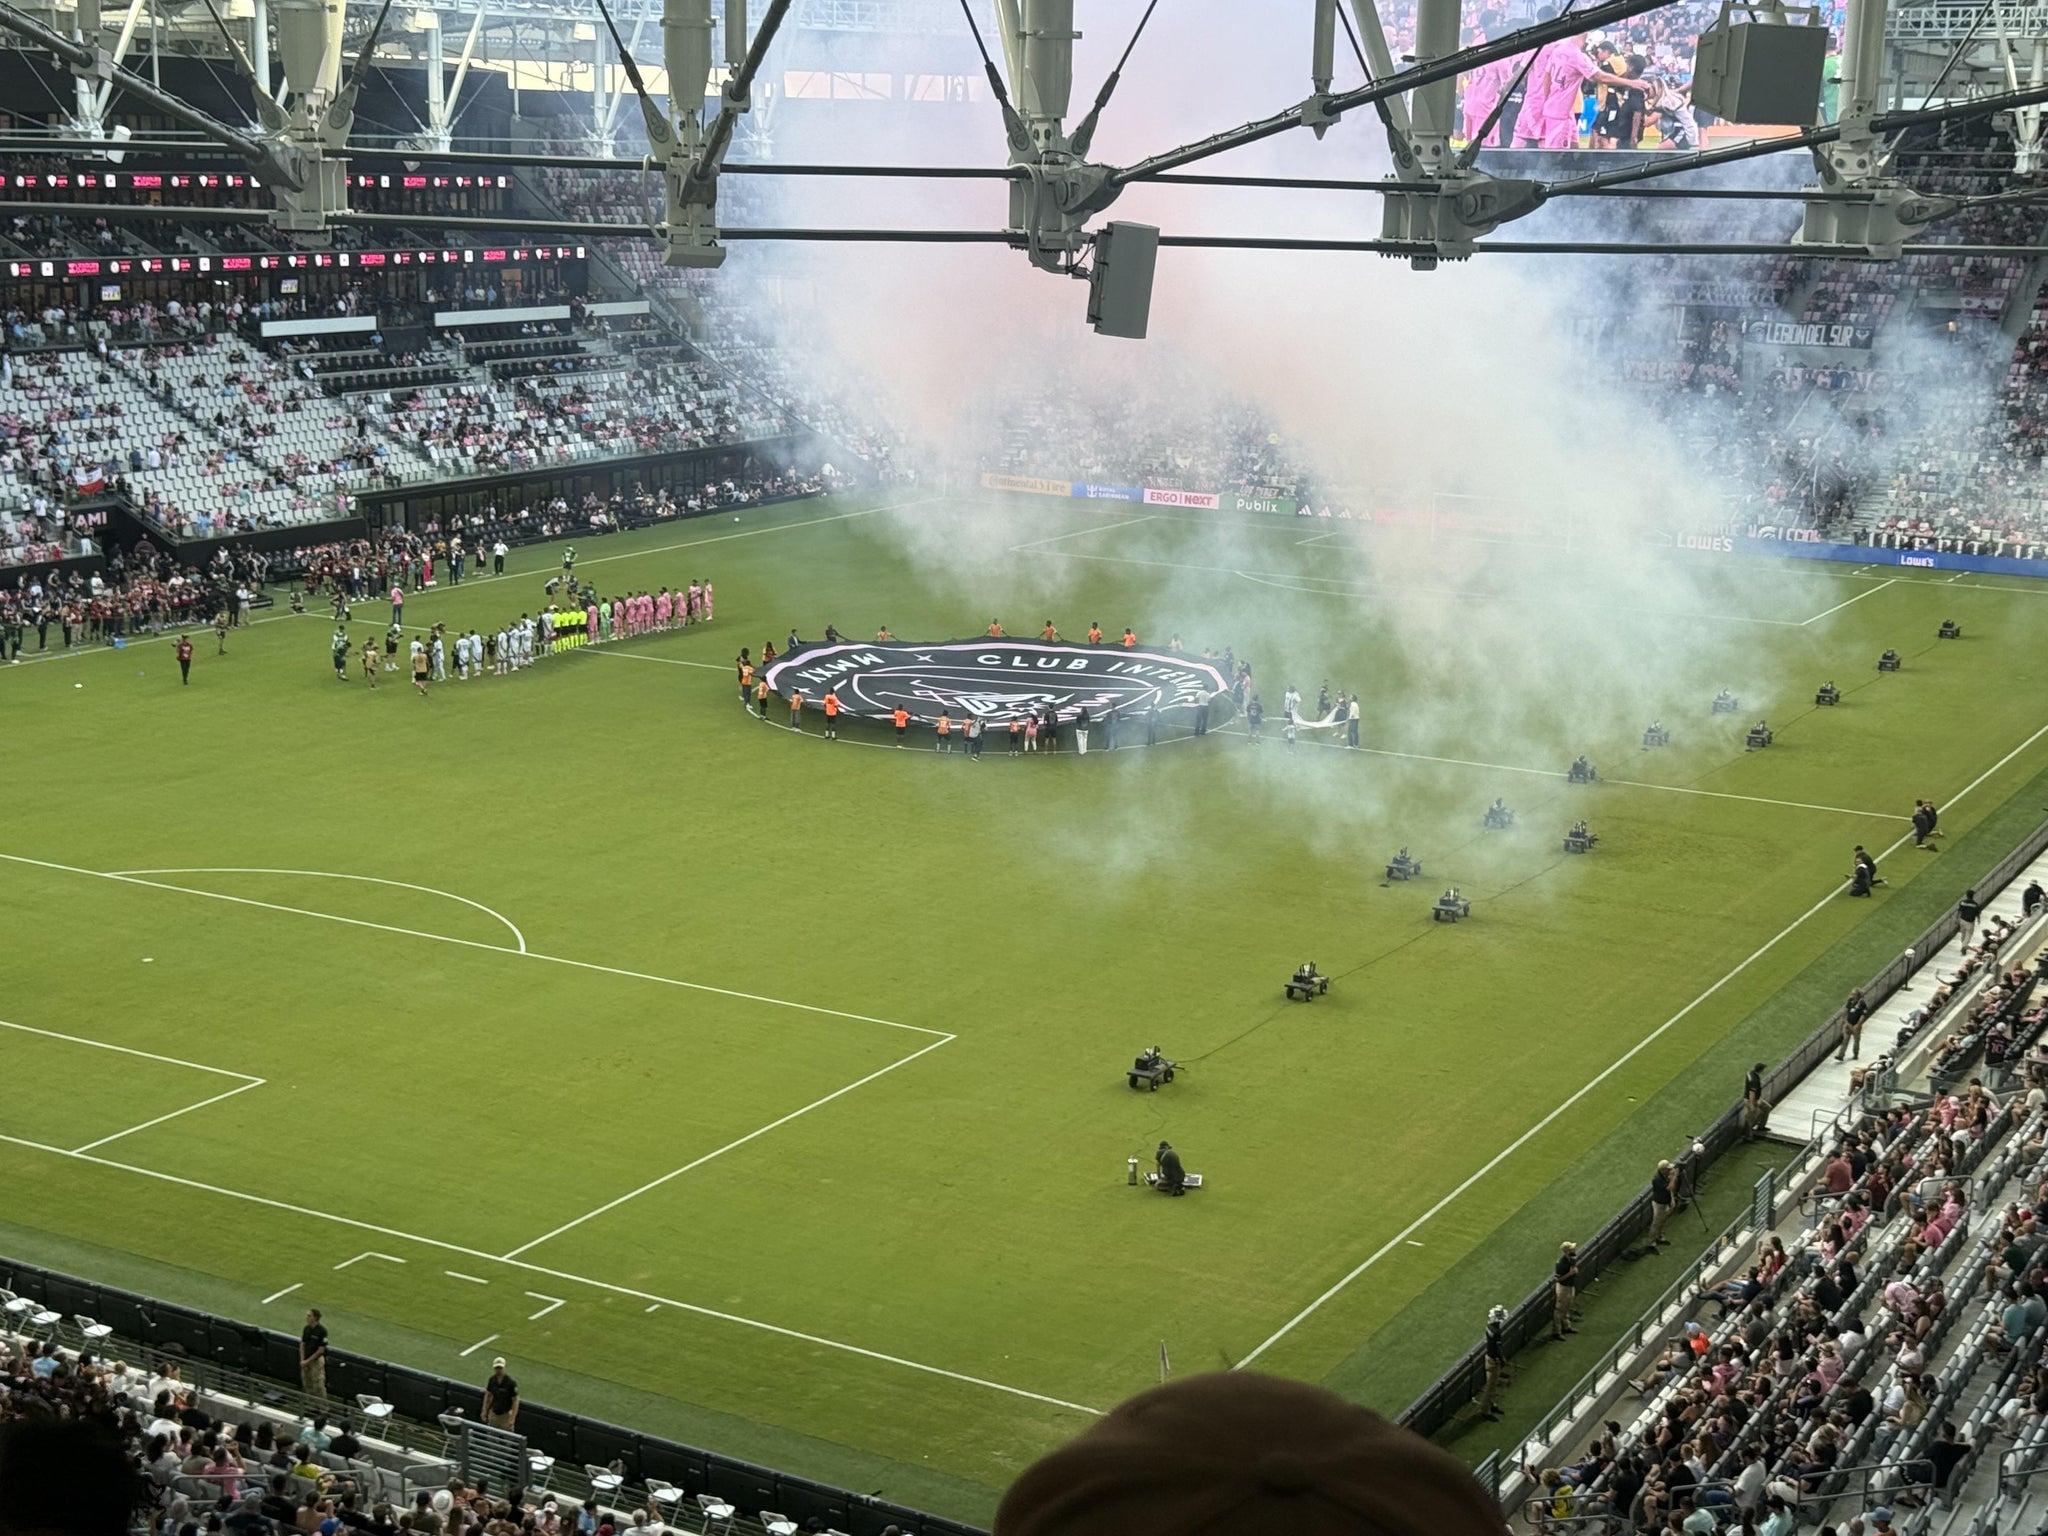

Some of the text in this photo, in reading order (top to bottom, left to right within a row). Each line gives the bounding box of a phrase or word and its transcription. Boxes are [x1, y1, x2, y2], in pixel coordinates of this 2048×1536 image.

[1805, 323, 1828, 346] DEL
[1829, 324, 1854, 347] SUR
[1150, 491, 1178, 503] ERGO
[1236, 498, 1278, 513] Publix
[75, 511, 108, 528] AMI
[1900, 555, 1935, 568] LOWE'S
[976, 654, 1089, 670] CLUB
